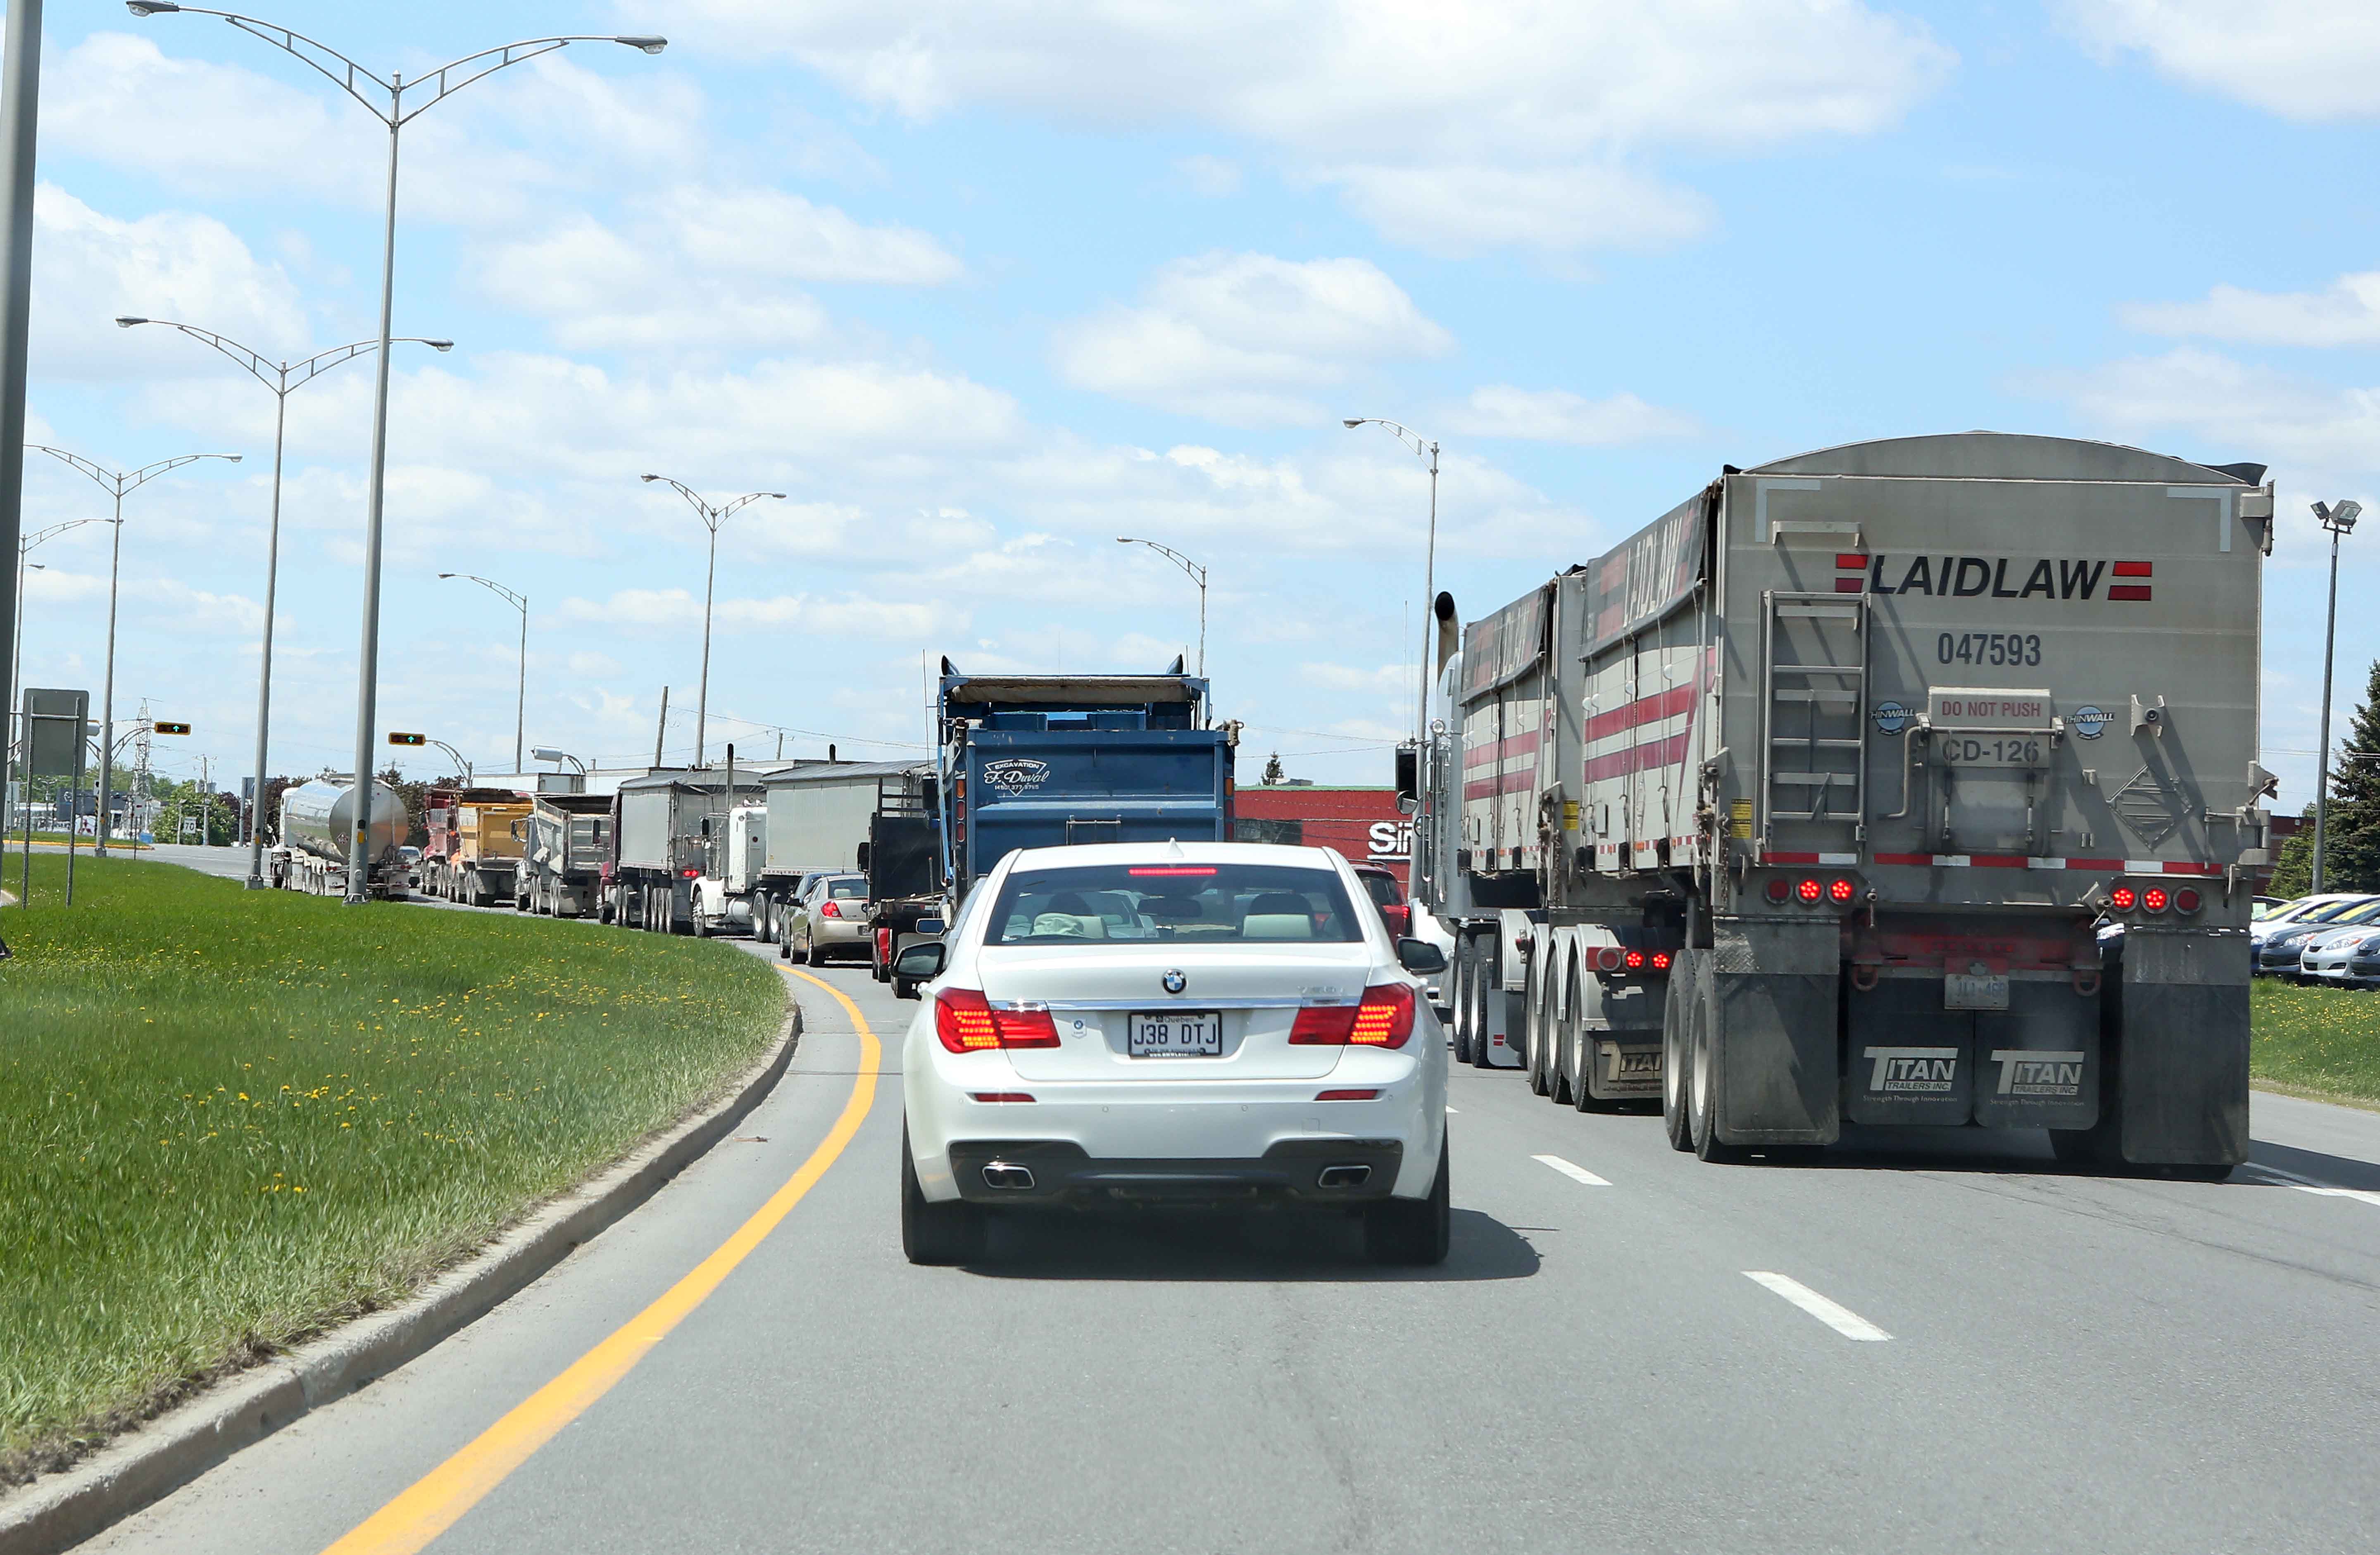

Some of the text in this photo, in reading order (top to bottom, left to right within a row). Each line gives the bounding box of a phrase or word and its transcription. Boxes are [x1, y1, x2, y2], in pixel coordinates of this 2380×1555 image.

[1869, 555, 2106, 600] LAIDLAW
[1937, 632, 2041, 666] 047593
[1869, 709, 1914, 719] HINWALL
[1942, 701, 2040, 717] DO NOT PUSH
[2066, 713, 2114, 723] THINWALL
[1942, 740, 2039, 762] CD-126
[984, 770, 1050, 784] F. Duval
[1134, 1024, 1216, 1044] J38 DTJ
[1864, 1046, 1958, 1090] TITAN
[1990, 1050, 2085, 1094] TITAN
[1894, 1095, 1919, 1103] Through
